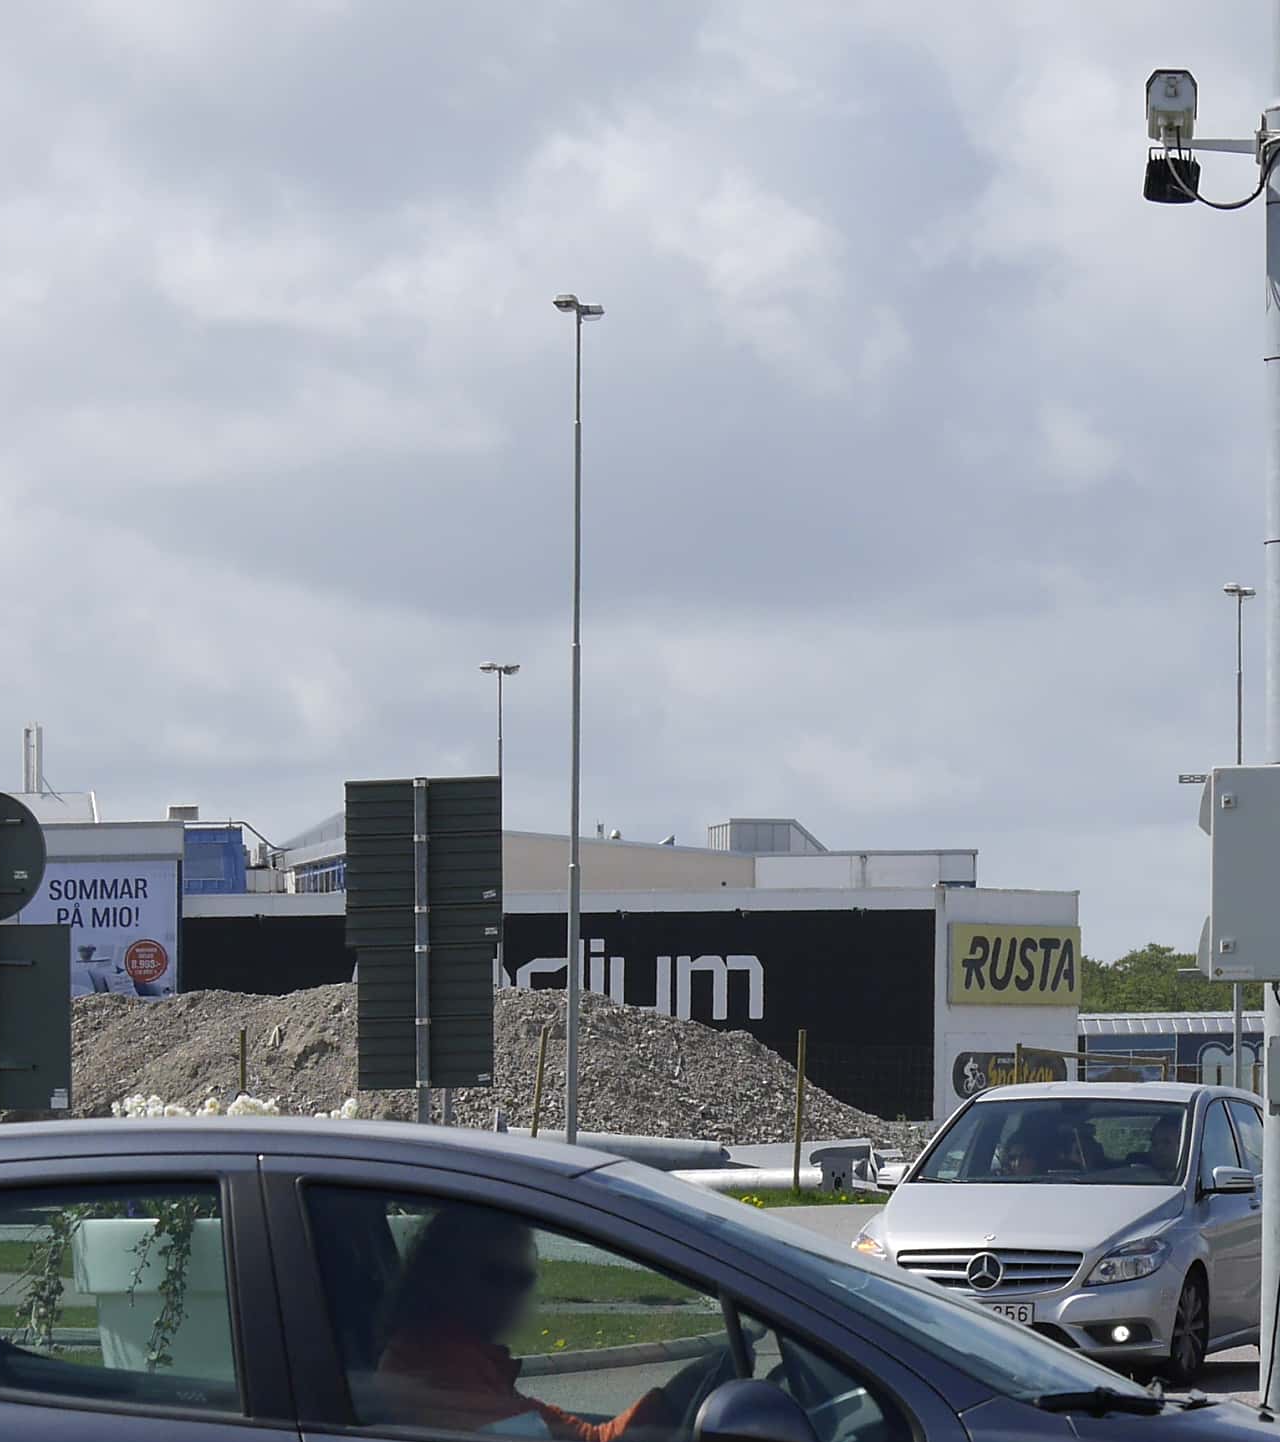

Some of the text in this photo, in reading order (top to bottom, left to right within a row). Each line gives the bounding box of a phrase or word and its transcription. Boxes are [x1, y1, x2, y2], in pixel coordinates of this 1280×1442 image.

[48, 878, 148, 901] SOMMAR
[56, 902, 140, 929] PÅ MIO!
[962, 935, 1075, 992] RUSTA
